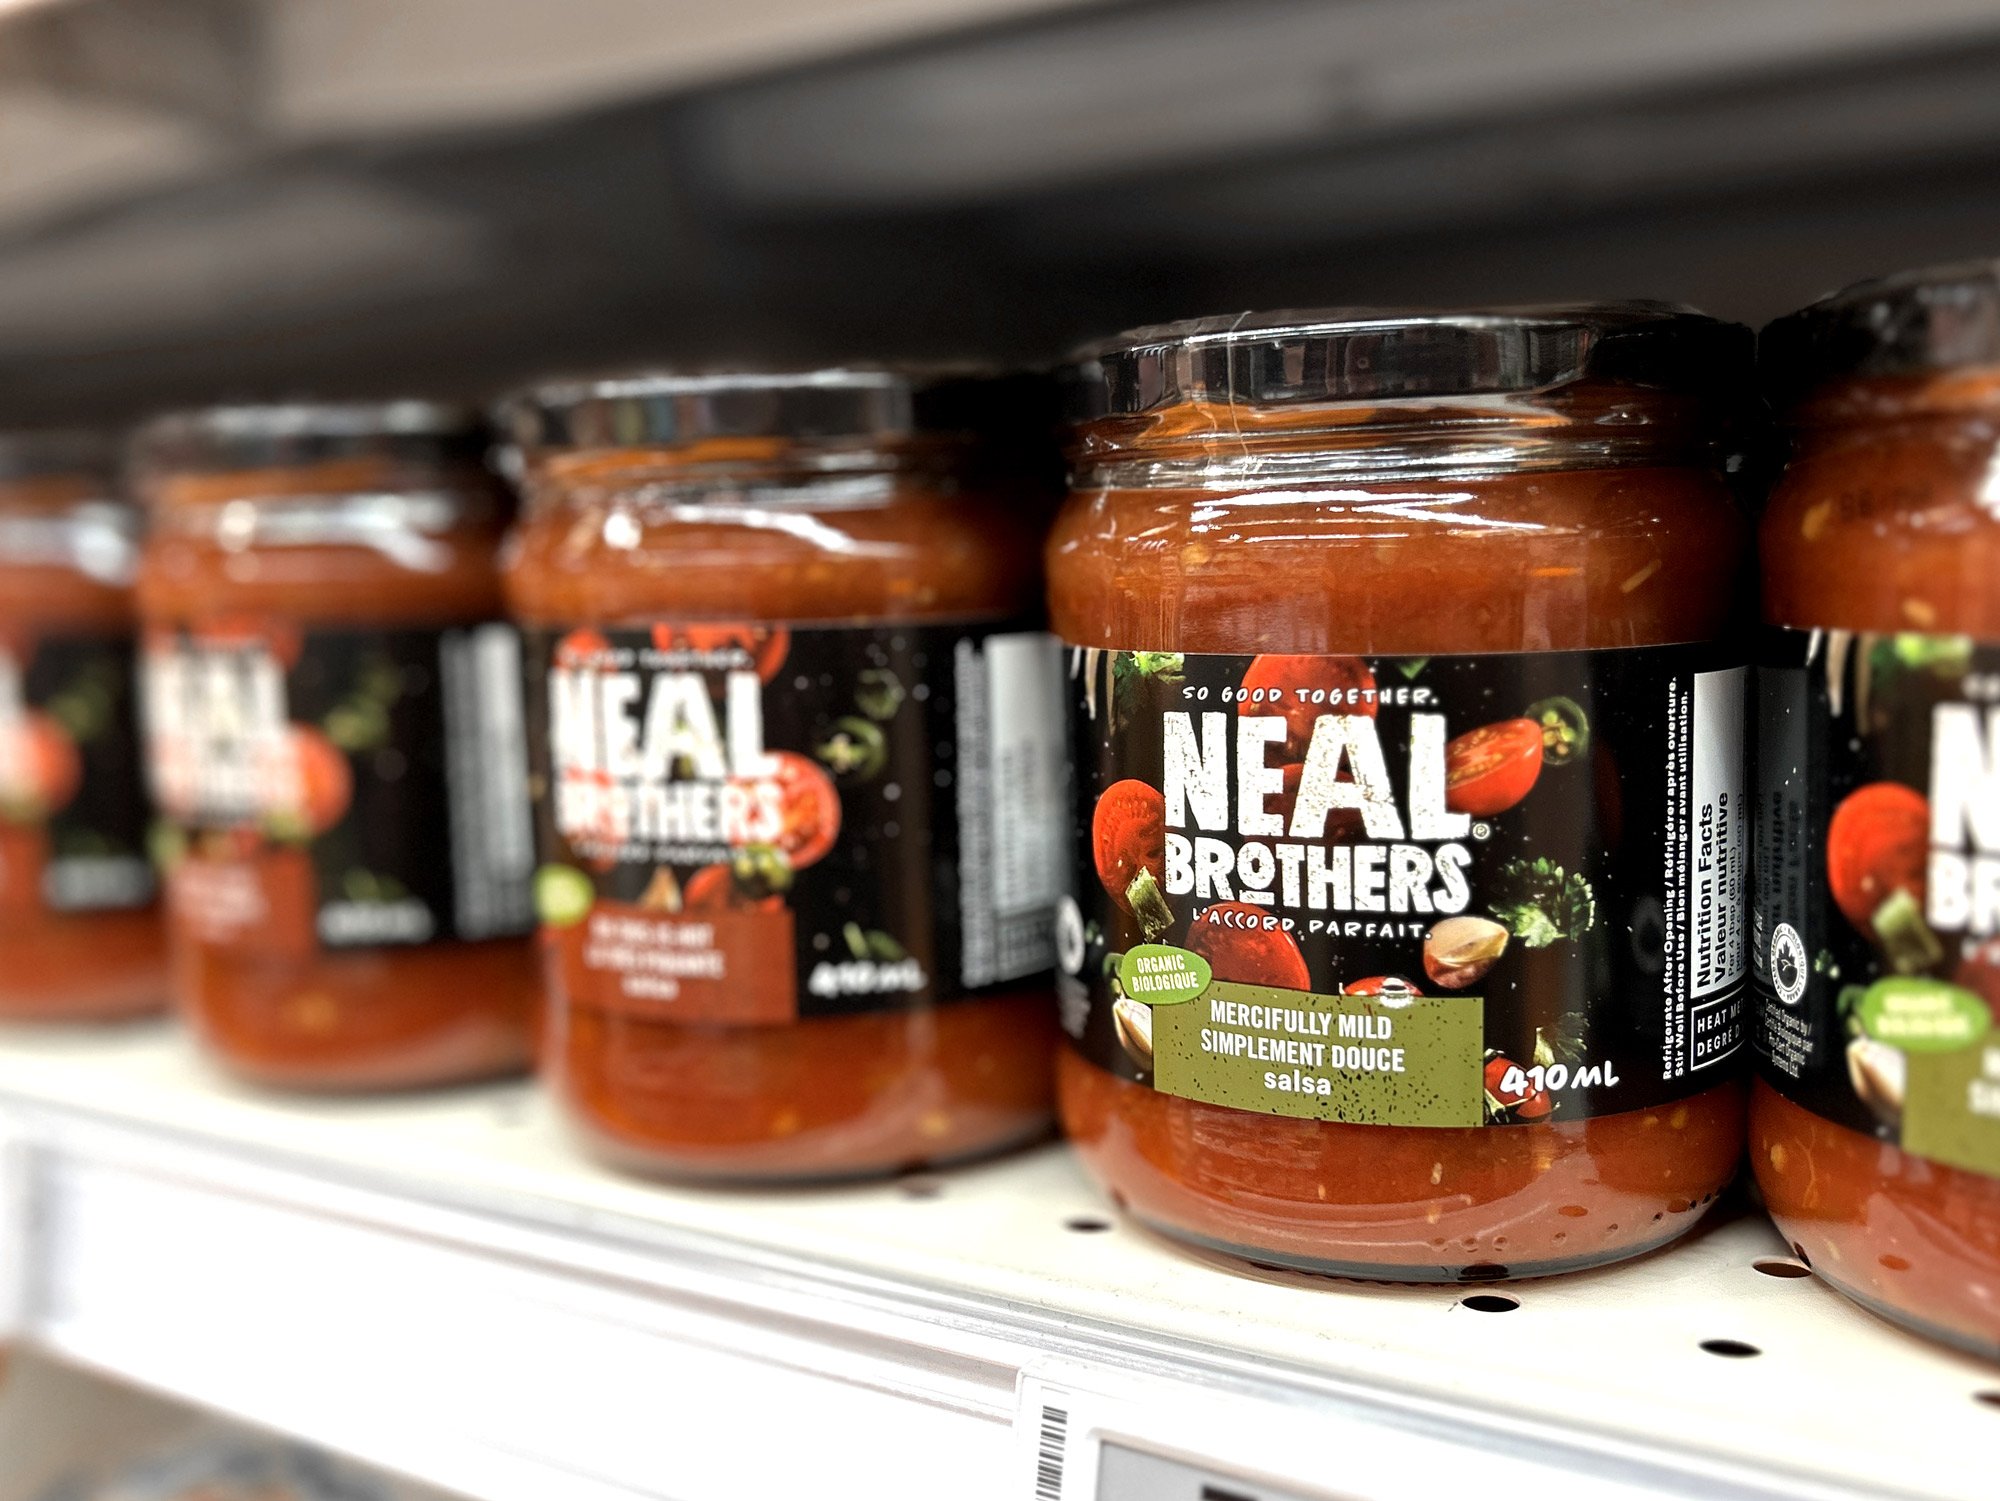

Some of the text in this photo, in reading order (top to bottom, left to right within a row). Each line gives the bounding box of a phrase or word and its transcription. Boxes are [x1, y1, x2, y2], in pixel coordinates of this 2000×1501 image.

[1182, 686, 1438, 704] SO GOOD TOGETHER.
[1163, 711, 1471, 840] NEAL
[1666, 753, 1677, 797] après
[1678, 774, 1688, 816] avant
[1665, 799, 1677, 879] Réfrigérer
[1677, 819, 1688, 886] mélanger
[1164, 836, 1472, 914] BROTHERS
[1715, 792, 1728, 984] Valeur nutritive
[1676, 890, 1686, 922] Bien
[1697, 803, 1712, 988] Nutrition Facts
[1192, 907, 1432, 940] L'ACCORD PARFAIT.
[1664, 889, 1675, 953] Opening
[1136, 954, 1185, 973] ORGANIC
[1676, 932, 1685, 960] Use
[1131, 972, 1199, 993] BIOLOGIQUE
[1663, 957, 1674, 994] After
[1676, 959, 1685, 1012] Before
[1210, 999, 1392, 1040] MERCIFULLY MILD
[1663, 997, 1674, 1080] Refrigerate
[1675, 1015, 1685, 1049] Well
[1697, 1009, 1727, 1034] HEAT
[1201, 1028, 1405, 1073] SIMPLEMENT DOUCE
[1697, 1025, 1733, 1057] DEGRÉ
[1263, 1069, 1331, 1096] salsa
[1499, 1060, 1619, 1096] 410 ML
[1675, 1050, 1684, 1077] Stir
